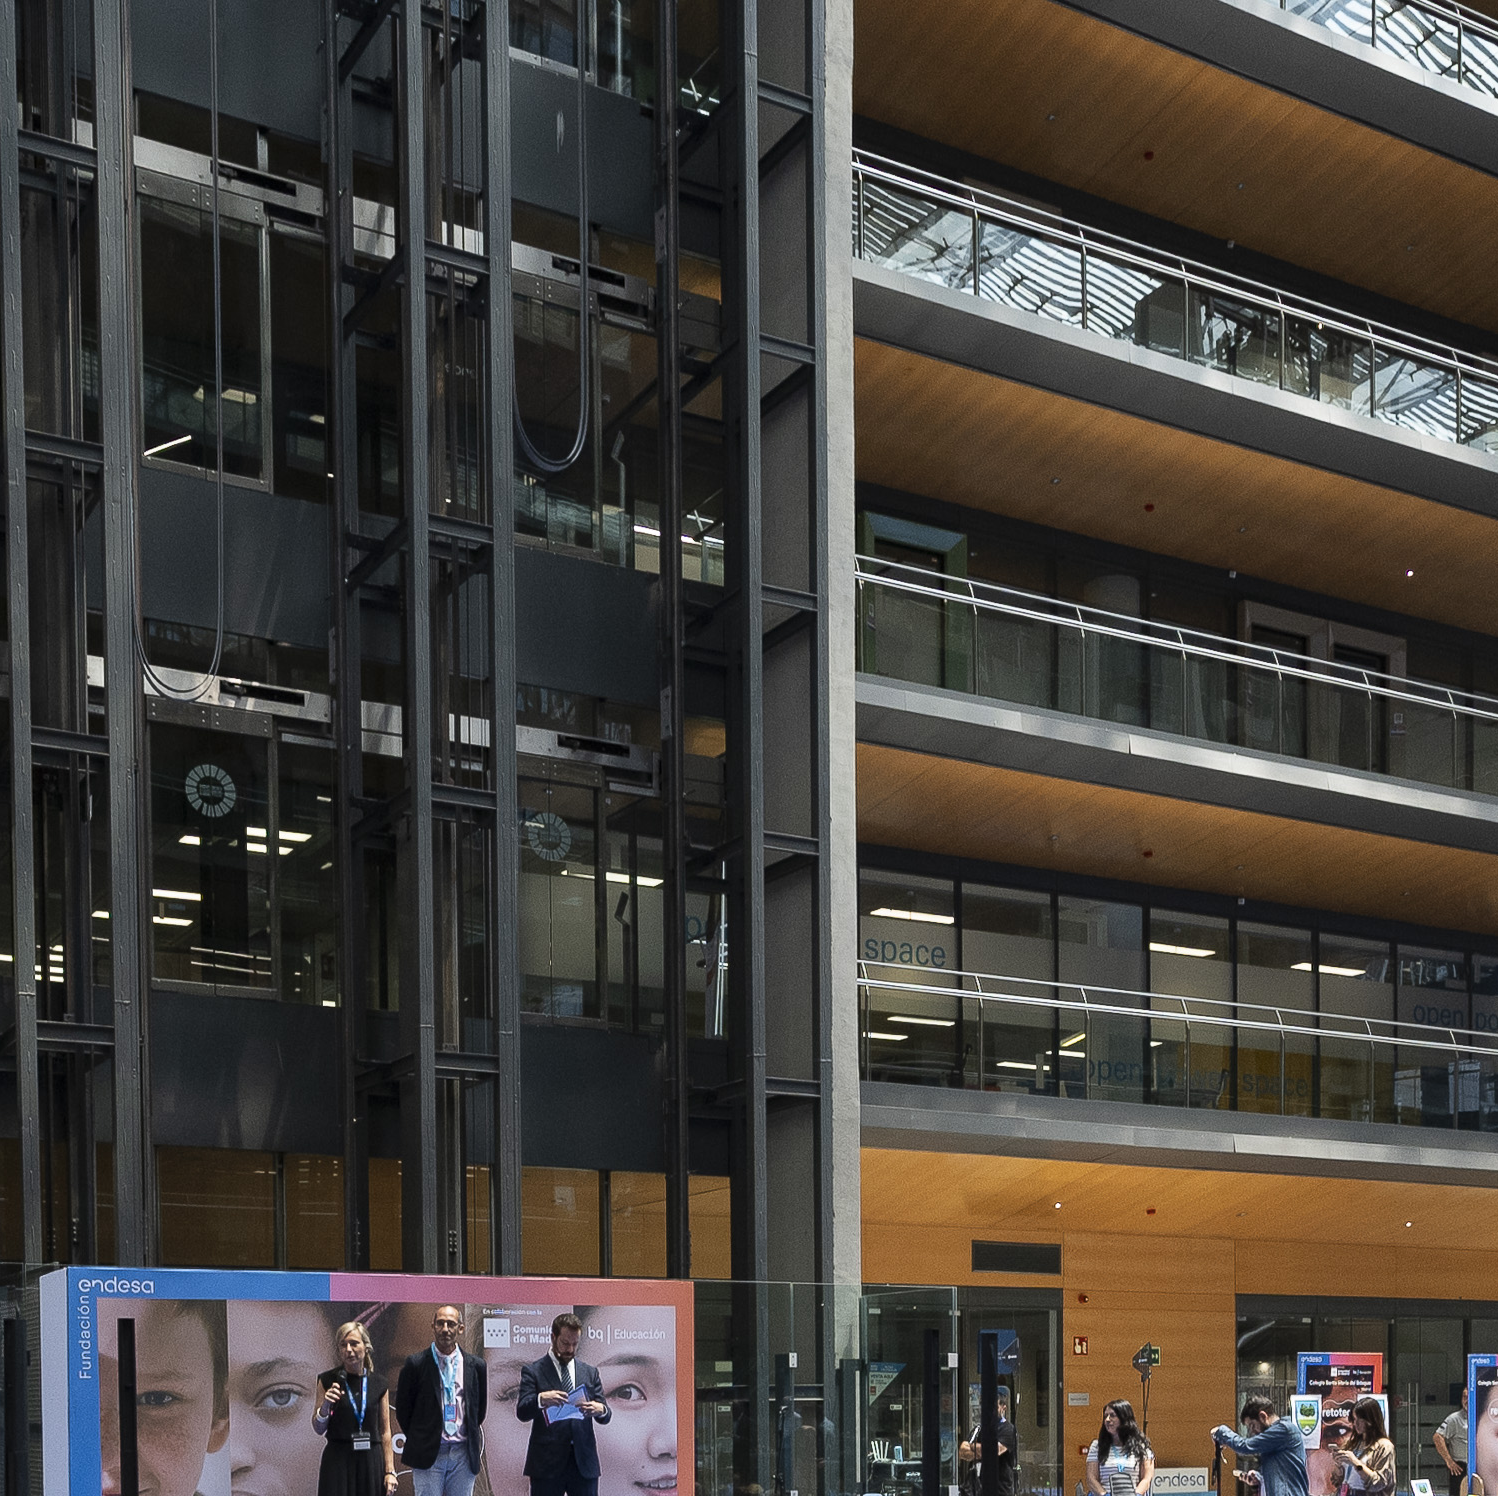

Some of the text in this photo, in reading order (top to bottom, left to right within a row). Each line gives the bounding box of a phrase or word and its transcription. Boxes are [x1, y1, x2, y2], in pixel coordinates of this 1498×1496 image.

[864, 937, 946, 968] space
[1413, 1004, 1465, 1028] open
[78, 1276, 154, 1294] endesa
[78, 1294, 91, 1379] Fundación
[513, 1324, 553, 1334] Comuni
[588, 1326, 666, 1342] bq Educación
[513, 1334, 553, 1344] de Mad
[1154, 1472, 1206, 1488] endesa
